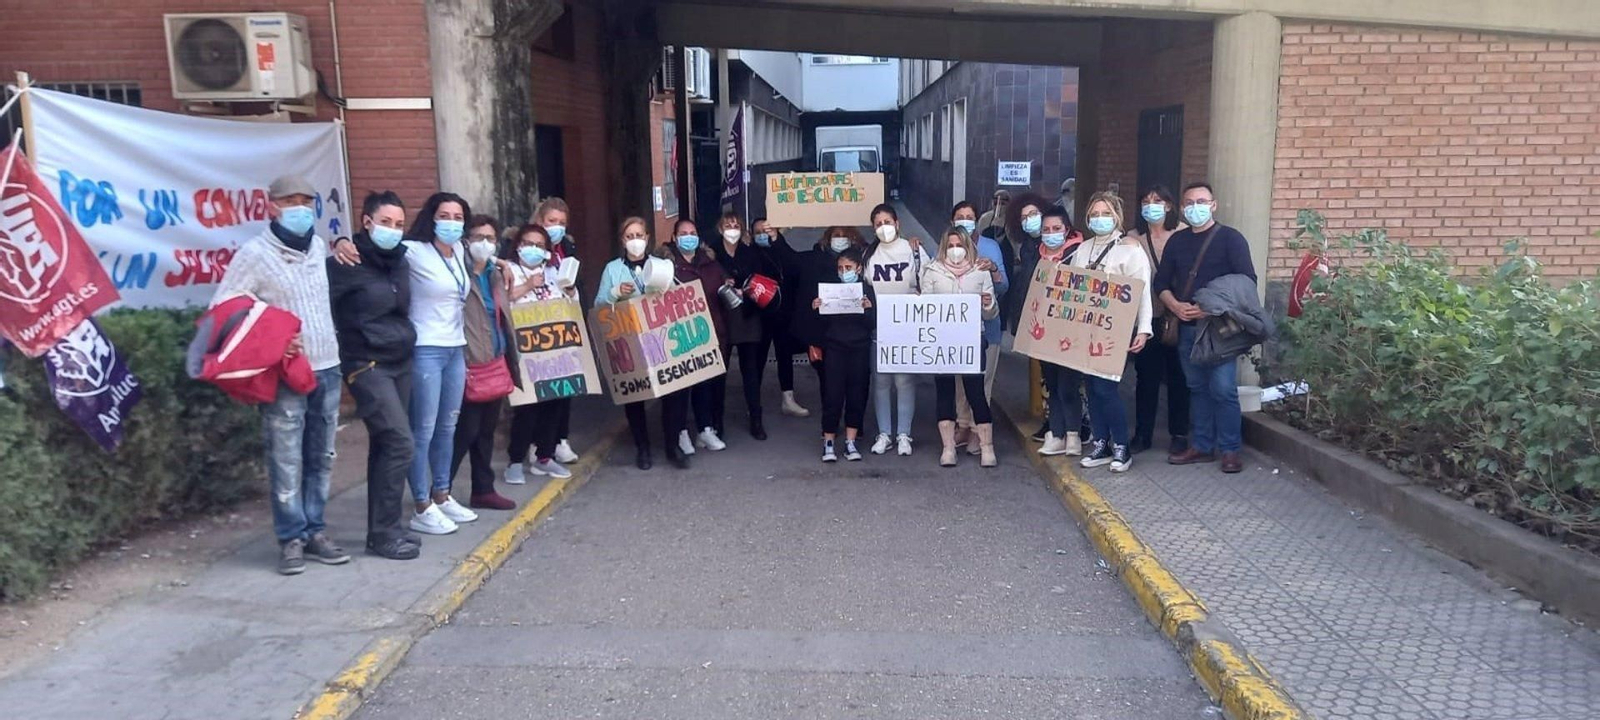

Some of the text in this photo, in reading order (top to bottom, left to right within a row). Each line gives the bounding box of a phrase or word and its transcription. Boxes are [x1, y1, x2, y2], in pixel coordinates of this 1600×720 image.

[58, 169, 124, 229] POR
[138, 188, 184, 230] UN
[777, 187, 866, 204] NO ESCLAVAS
[113, 251, 158, 290] UN
[872, 262, 909, 282] NY
[892, 303, 970, 323] LIMPIAR
[1088, 296, 1110, 310] SON
[597, 302, 643, 338] SIN
[606, 336, 635, 375] NO
[667, 315, 710, 358] SALUD
[918, 327, 937, 343] ES
[880, 345, 975, 366] NECESARIO
